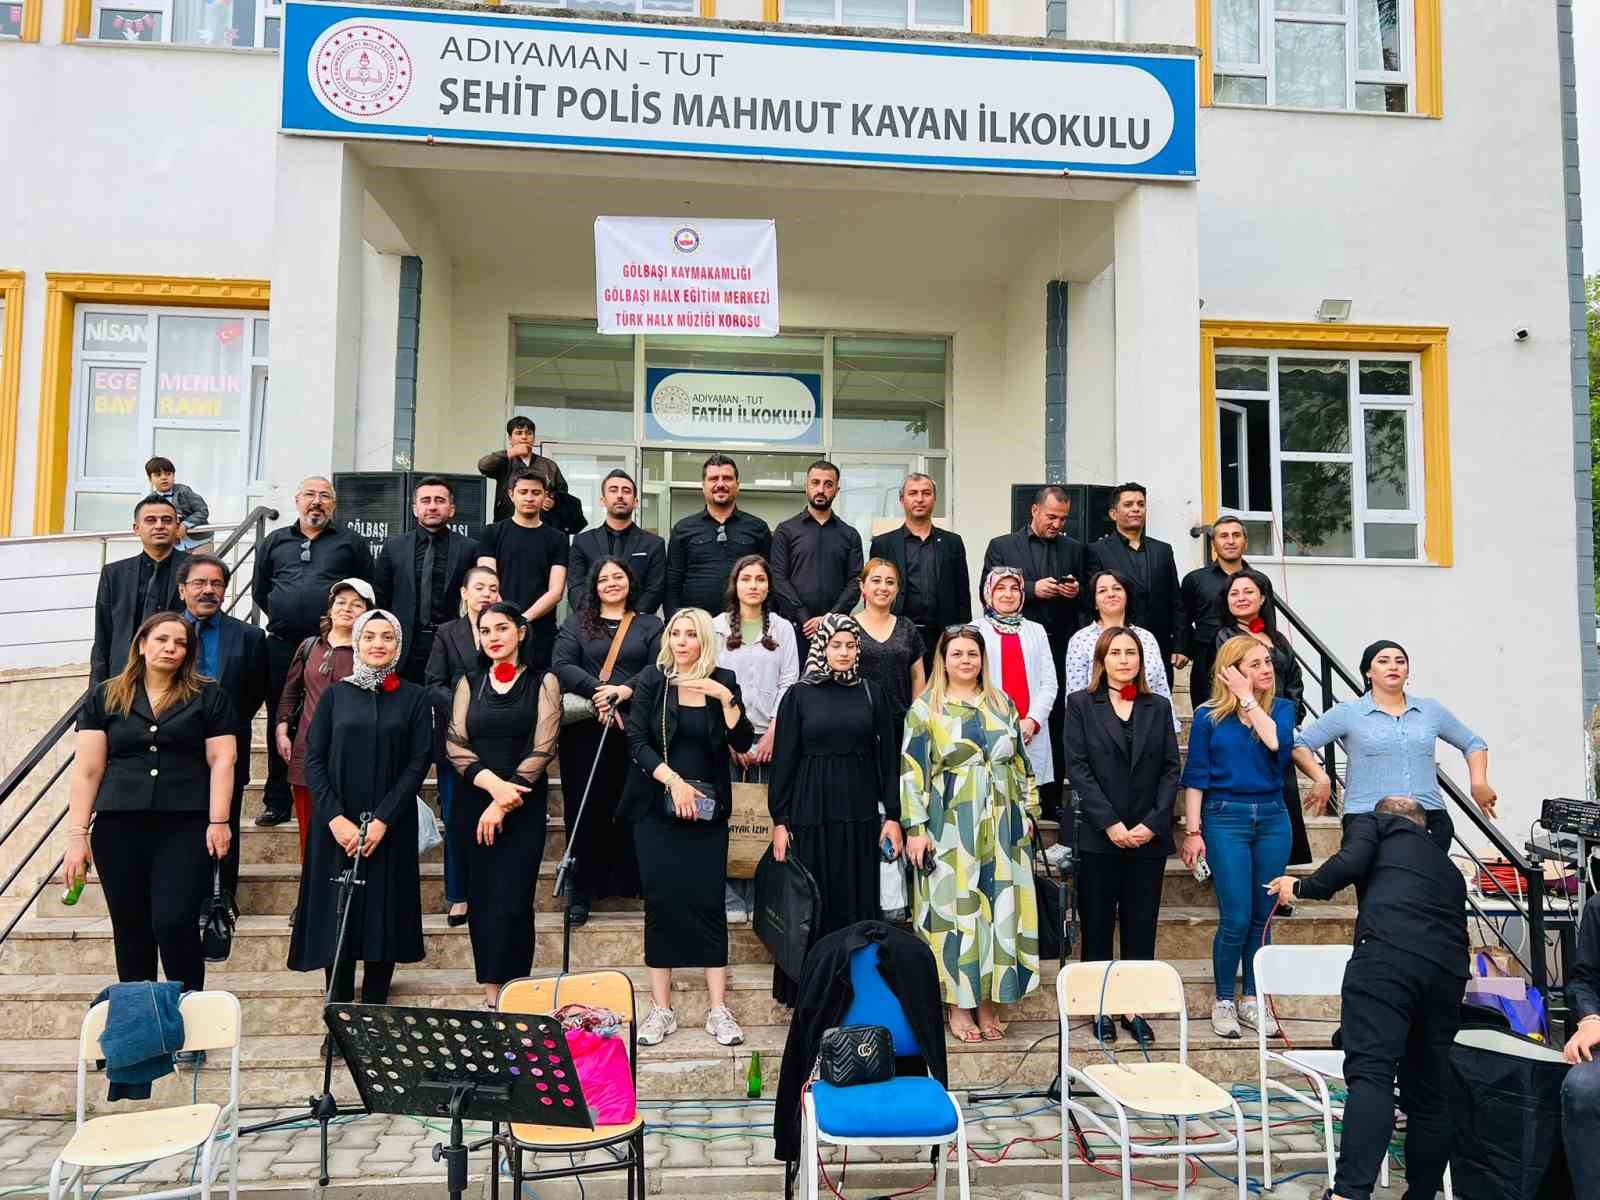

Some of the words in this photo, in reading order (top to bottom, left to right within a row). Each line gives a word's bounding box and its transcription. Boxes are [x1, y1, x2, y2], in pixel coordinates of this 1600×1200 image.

[440, 36, 628, 72] ADIYAMAN
[657, 50, 724, 78] TUT
[439, 75, 547, 117] ŞEHİT
[556, 83, 662, 125] POLİS
[672, 93, 842, 135] MAHMUT
[851, 103, 968, 142] KAYAN
[978, 102, 1150, 151] İLKOKULU
[623, 262, 668, 282] GÖLBAŞI
[671, 264, 752, 281] KAYMAKAMLIĞI
[604, 286, 650, 305] GÖLBAŞI
[653, 289, 680, 304] HALK
[683, 286, 721, 304] EĞİTİM
[723, 287, 770, 305] MERKEZİ
[616, 310, 643, 327] TÜRK
[646, 313, 674, 328] HALK
[718, 313, 761, 329] KOROSU
[86, 320, 148, 343] NİSAN
[95, 372, 137, 391] EGE
[95, 395, 136, 415] BAY
[692, 393, 739, 405] ADIYAMAN
[745, 395, 764, 406] TUT
[691, 404, 733, 424] FATİH
[738, 404, 812, 425] İLKOKULU
